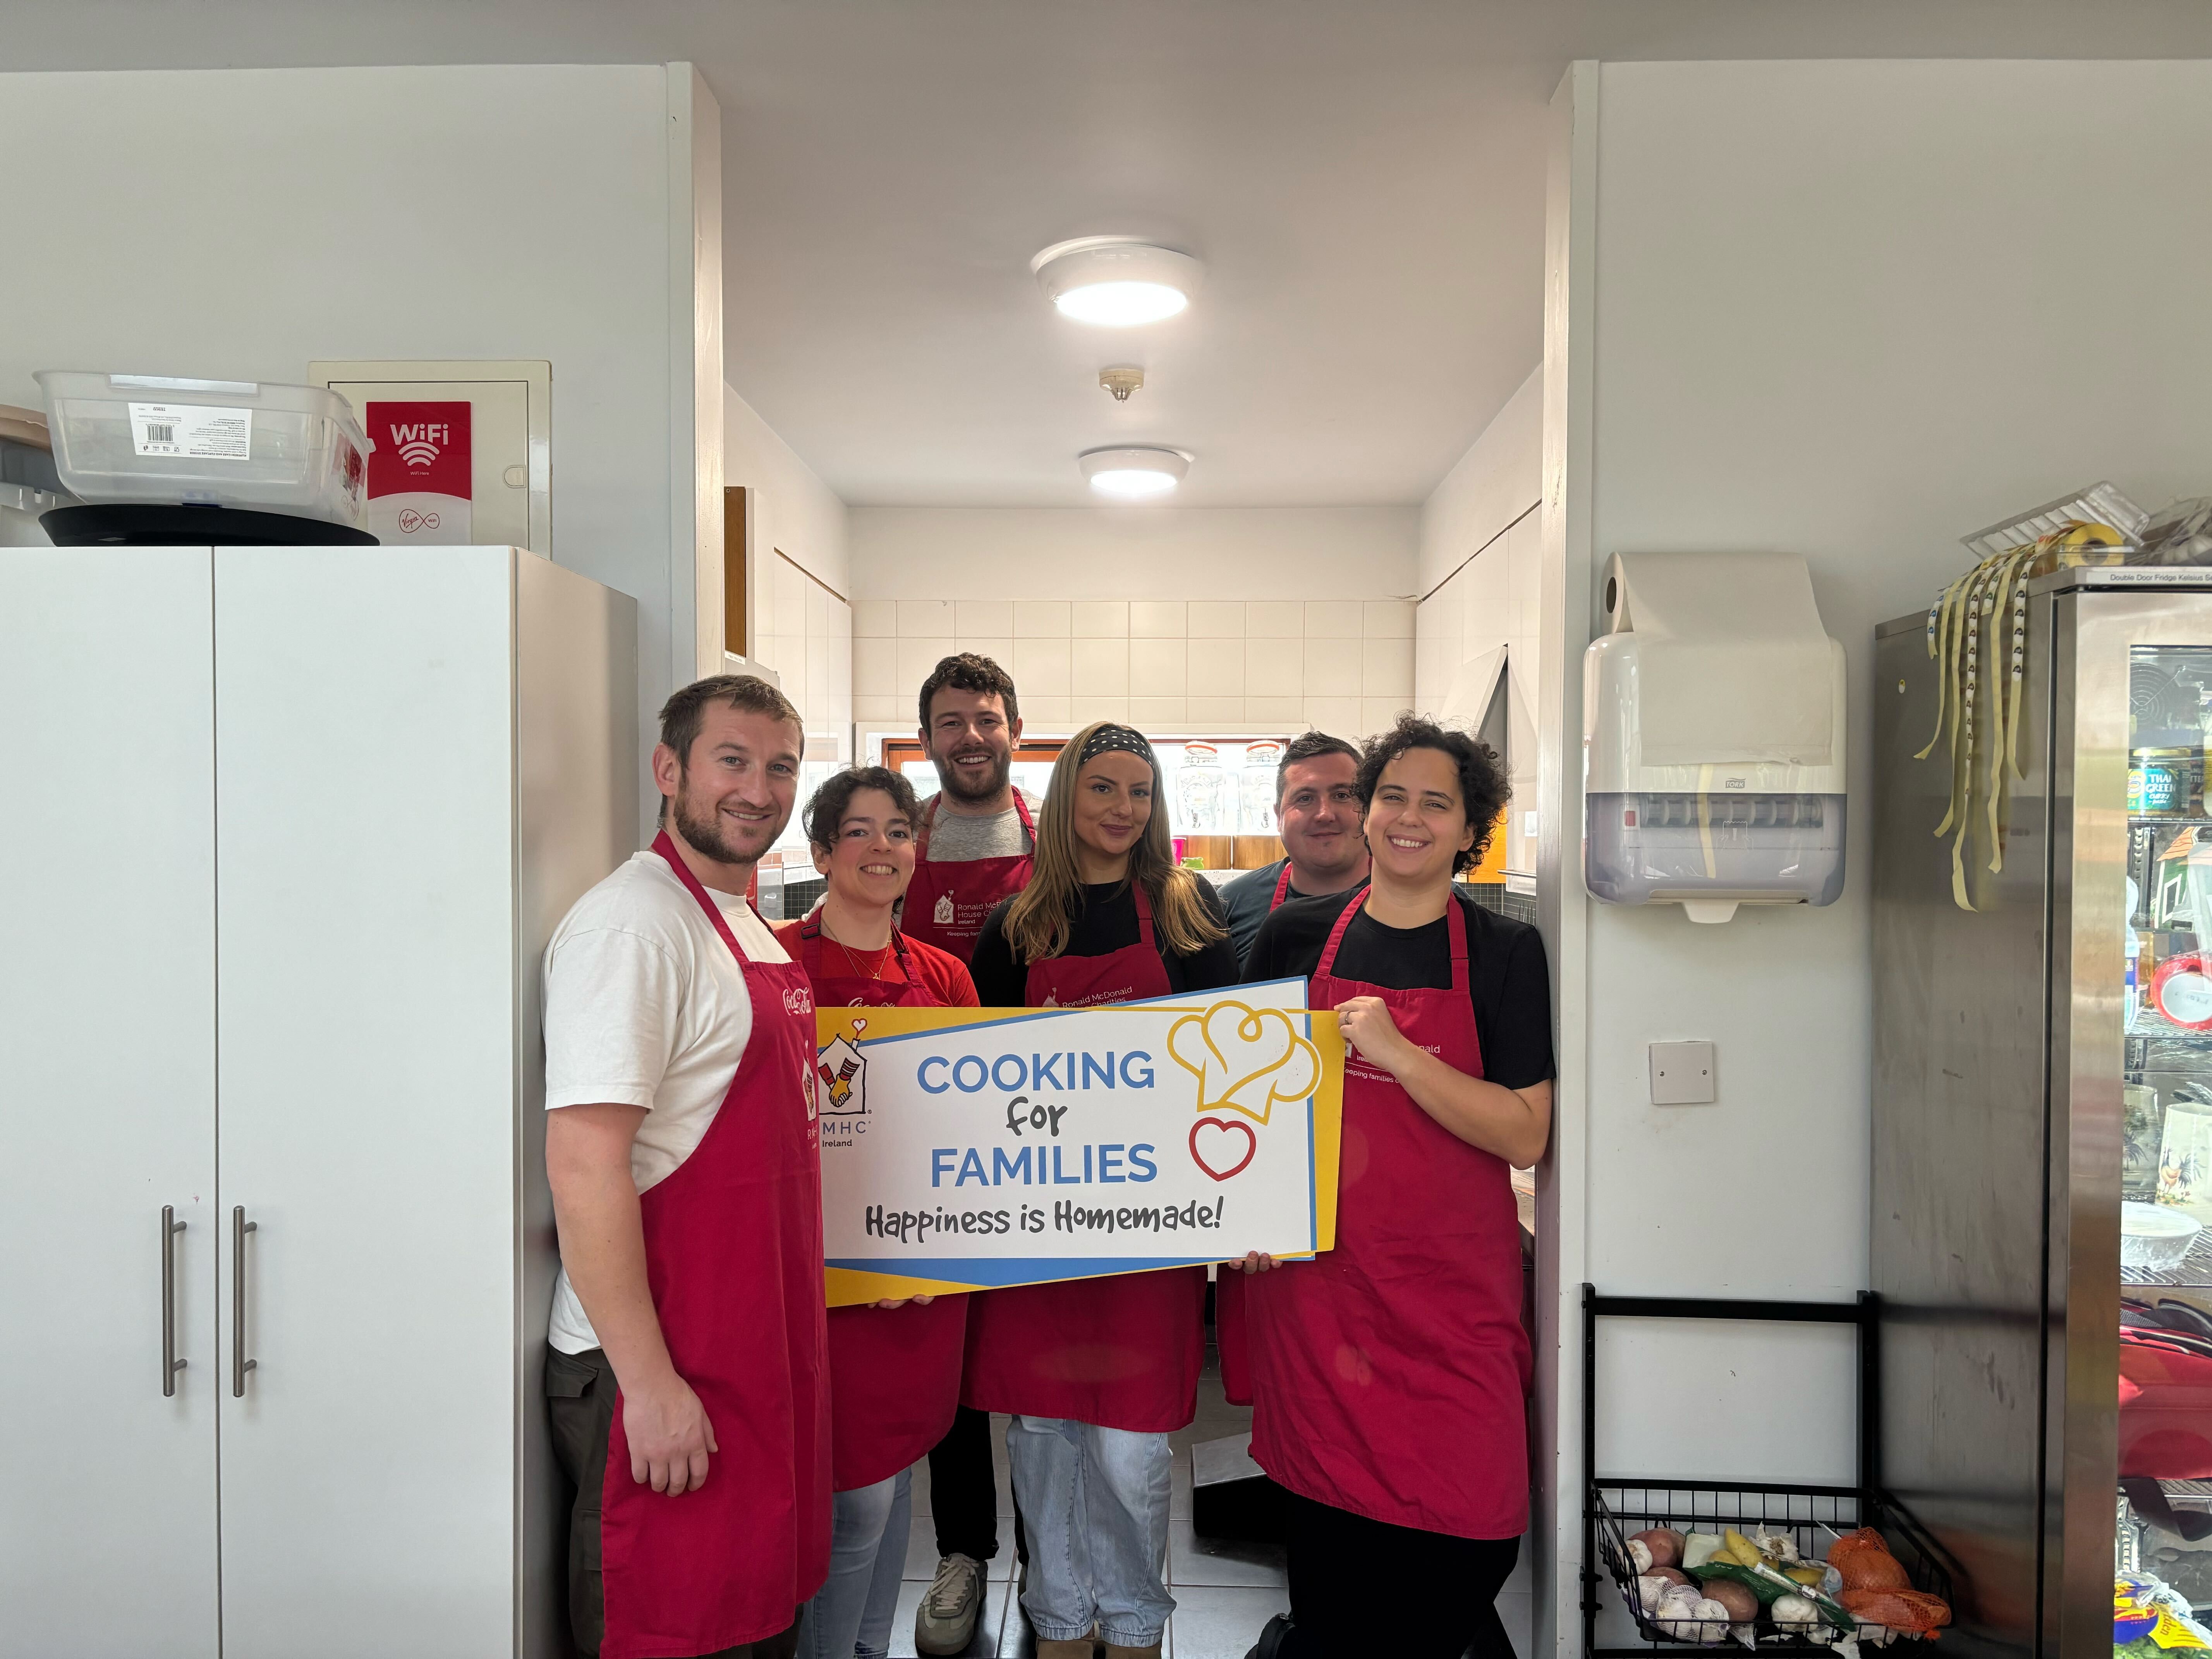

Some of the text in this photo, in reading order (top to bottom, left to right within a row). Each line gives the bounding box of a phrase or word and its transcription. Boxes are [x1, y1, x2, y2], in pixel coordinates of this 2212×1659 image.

[390, 424, 448, 445] WiFi
[402, 514, 419, 529] Virgin
[2148, 774, 2171, 783] THAI
[2145, 783, 2176, 793] GREEN
[1062, 986, 1133, 1008] Ronald McDonald
[1419, 1044, 1440, 1053] nald
[917, 1051, 1154, 1094] COOKING
[1369, 1073, 1394, 1083] families
[1006, 1096, 1068, 1137] for
[823, 1121, 866, 1135] MHC
[932, 1143, 1158, 1187] FAMILIES
[865, 1195, 1224, 1244] Happiness is Homemade!
